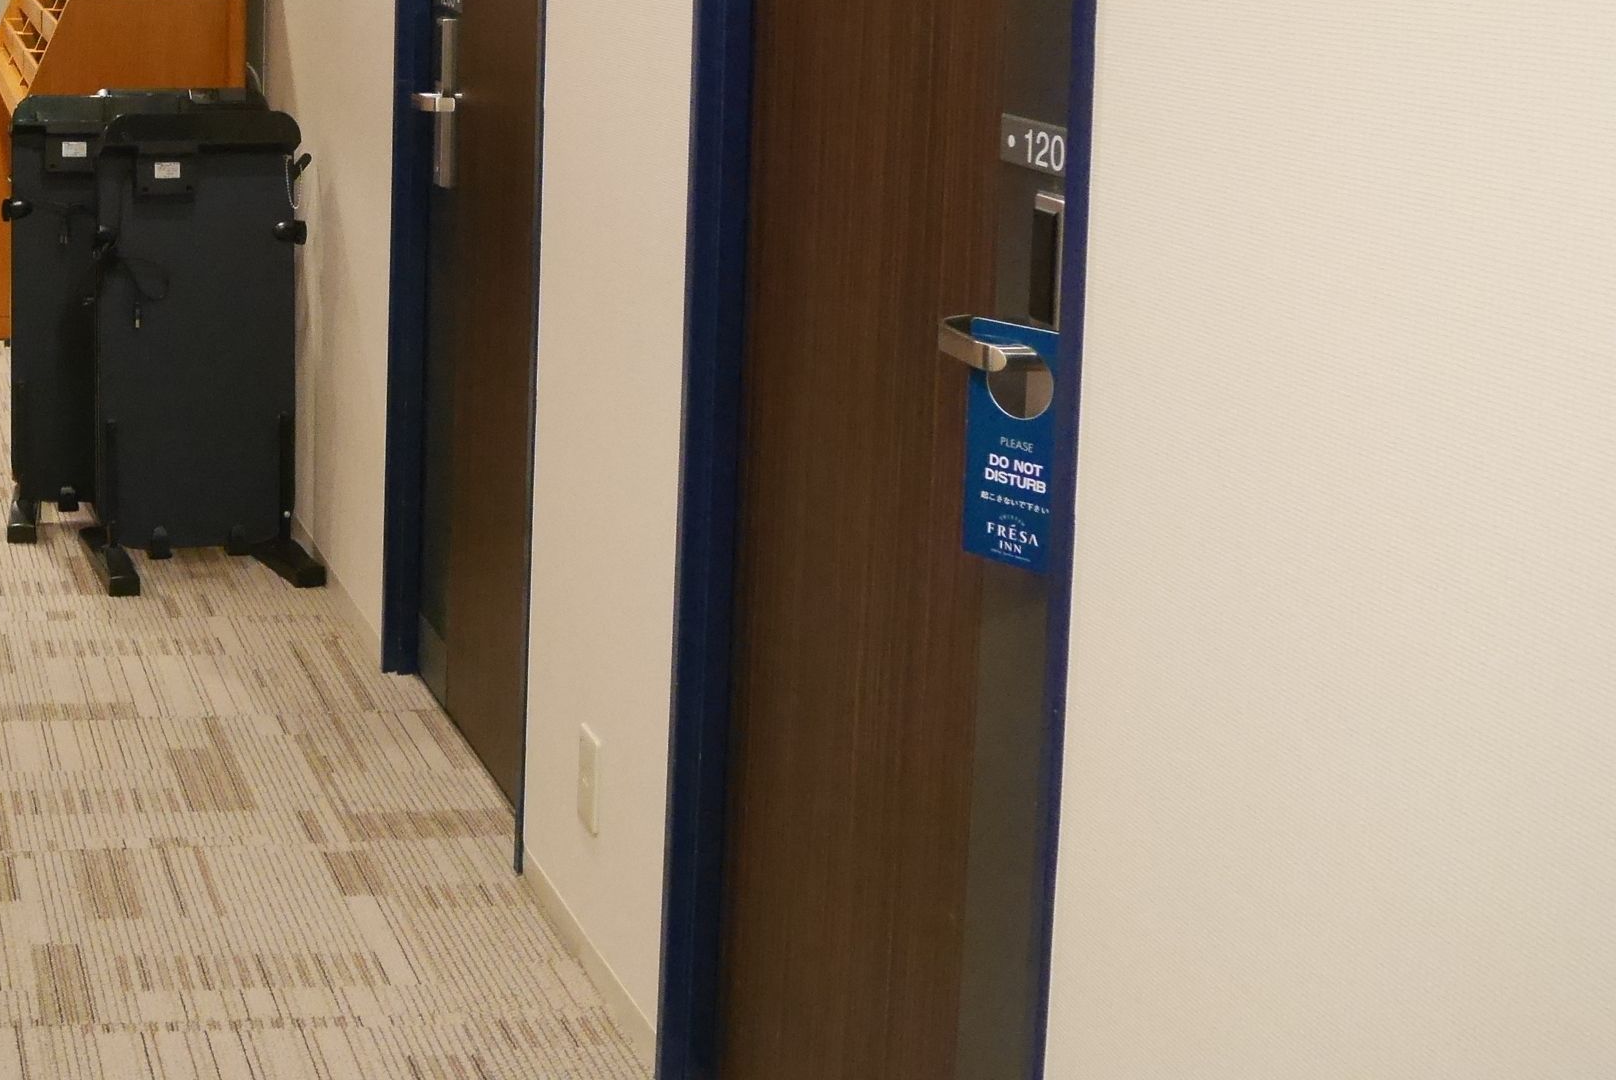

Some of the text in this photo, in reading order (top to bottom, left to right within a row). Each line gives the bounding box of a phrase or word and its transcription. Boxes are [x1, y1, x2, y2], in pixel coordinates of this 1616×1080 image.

[1024, 128, 1065, 172] 120
[1000, 436, 1034, 453] PLEASE
[989, 453, 1044, 477] DO NOT
[984, 467, 1047, 494] DISTURB
[999, 540, 1023, 555] INN
